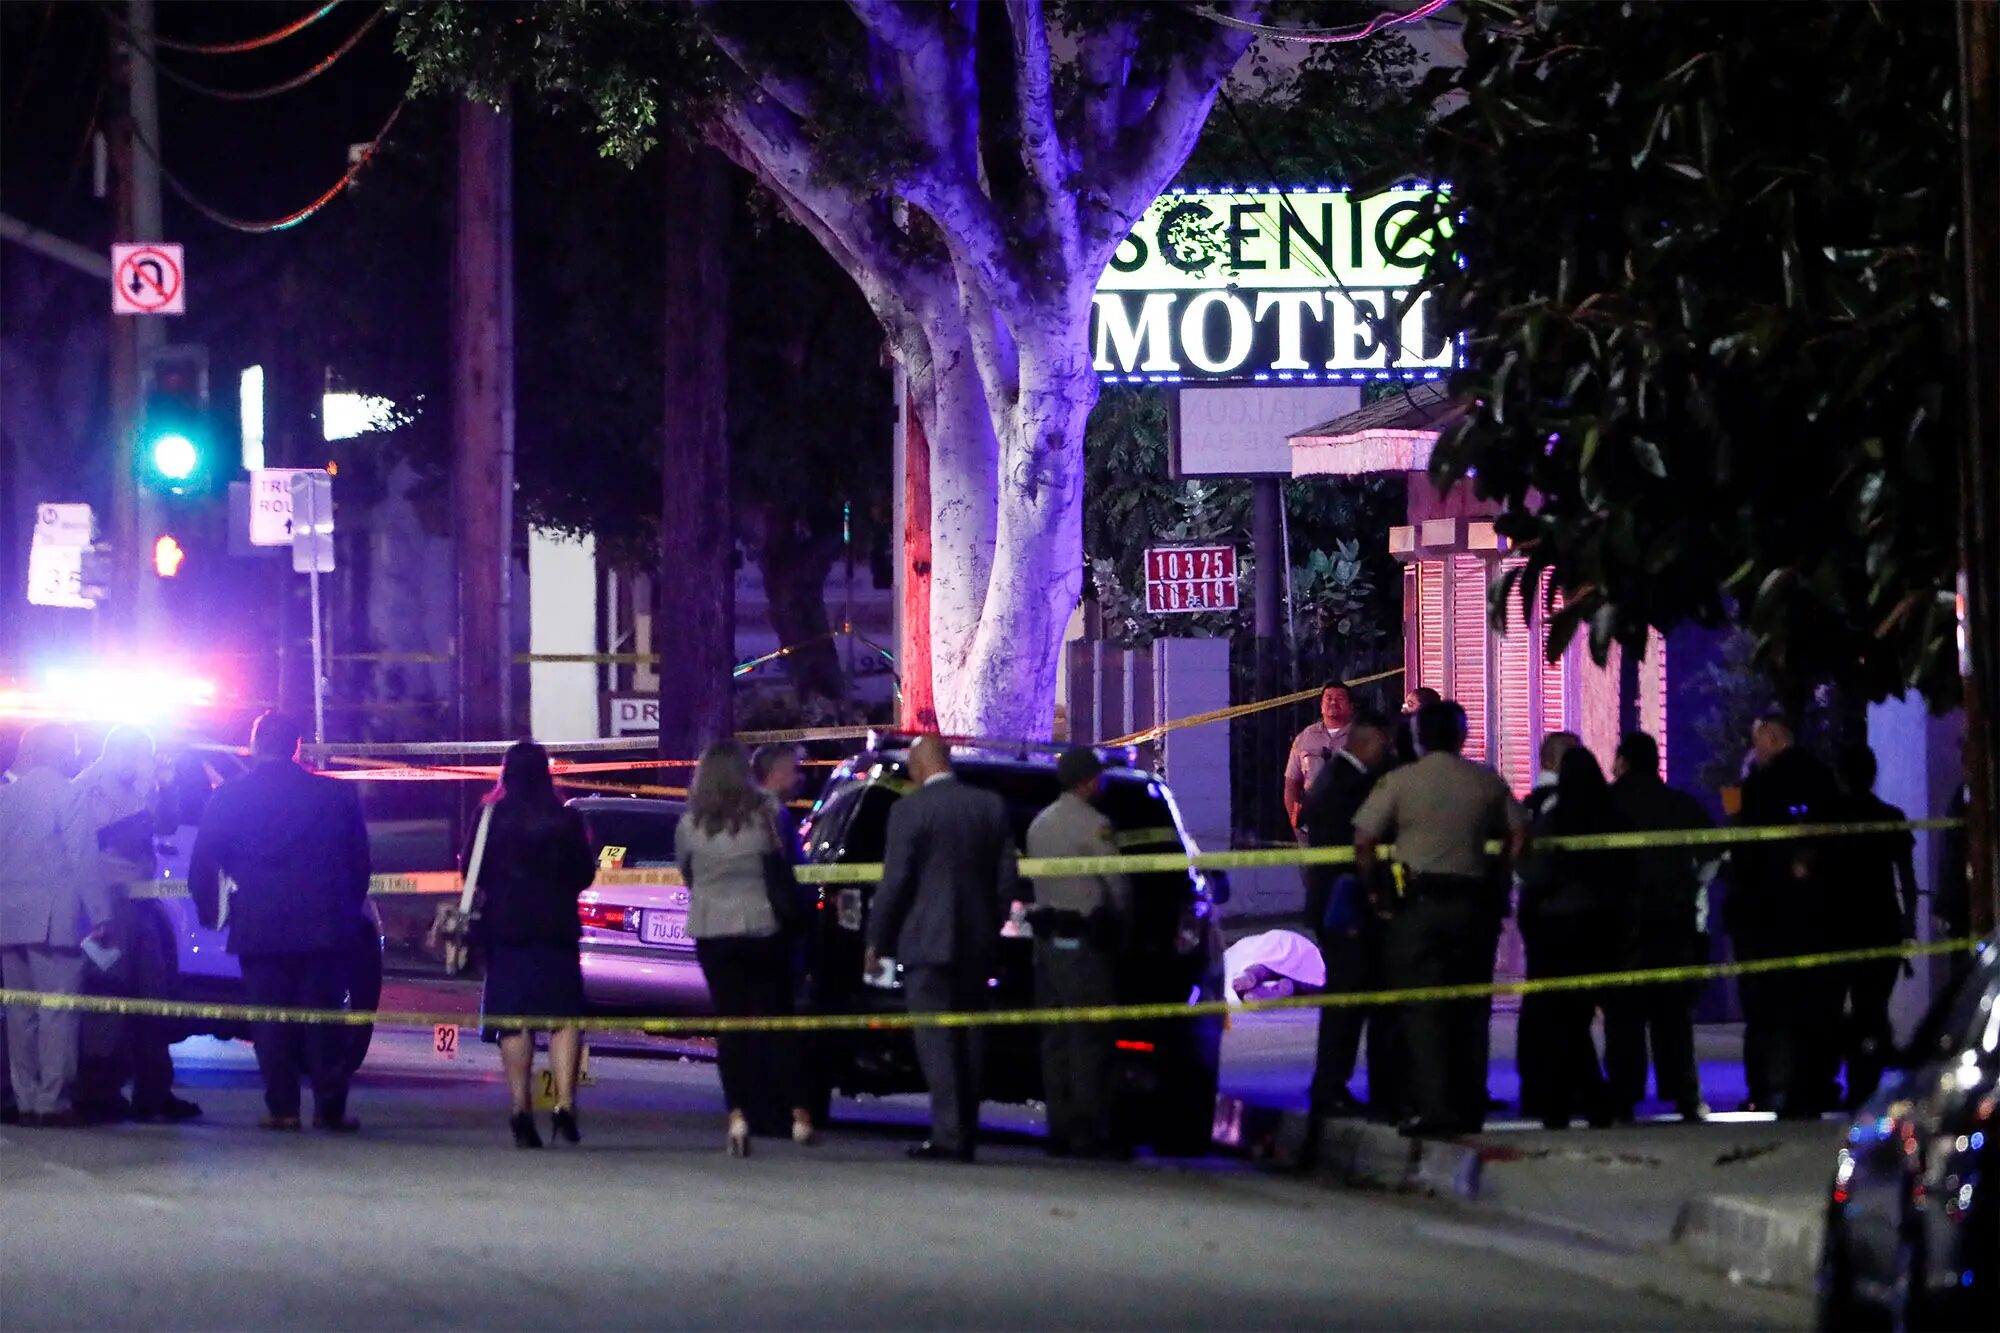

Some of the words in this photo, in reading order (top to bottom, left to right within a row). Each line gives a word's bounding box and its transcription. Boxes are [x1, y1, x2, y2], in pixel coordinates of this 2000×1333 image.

[1092, 290, 1453, 373] MOTEL
[1156, 552, 1224, 580] 10325
[1157, 581, 1225, 609] 10319
[621, 703, 660, 721] DR
[607, 847, 621, 858] 12
[437, 1027, 455, 1053] 32
[542, 1069, 557, 1098] 2
